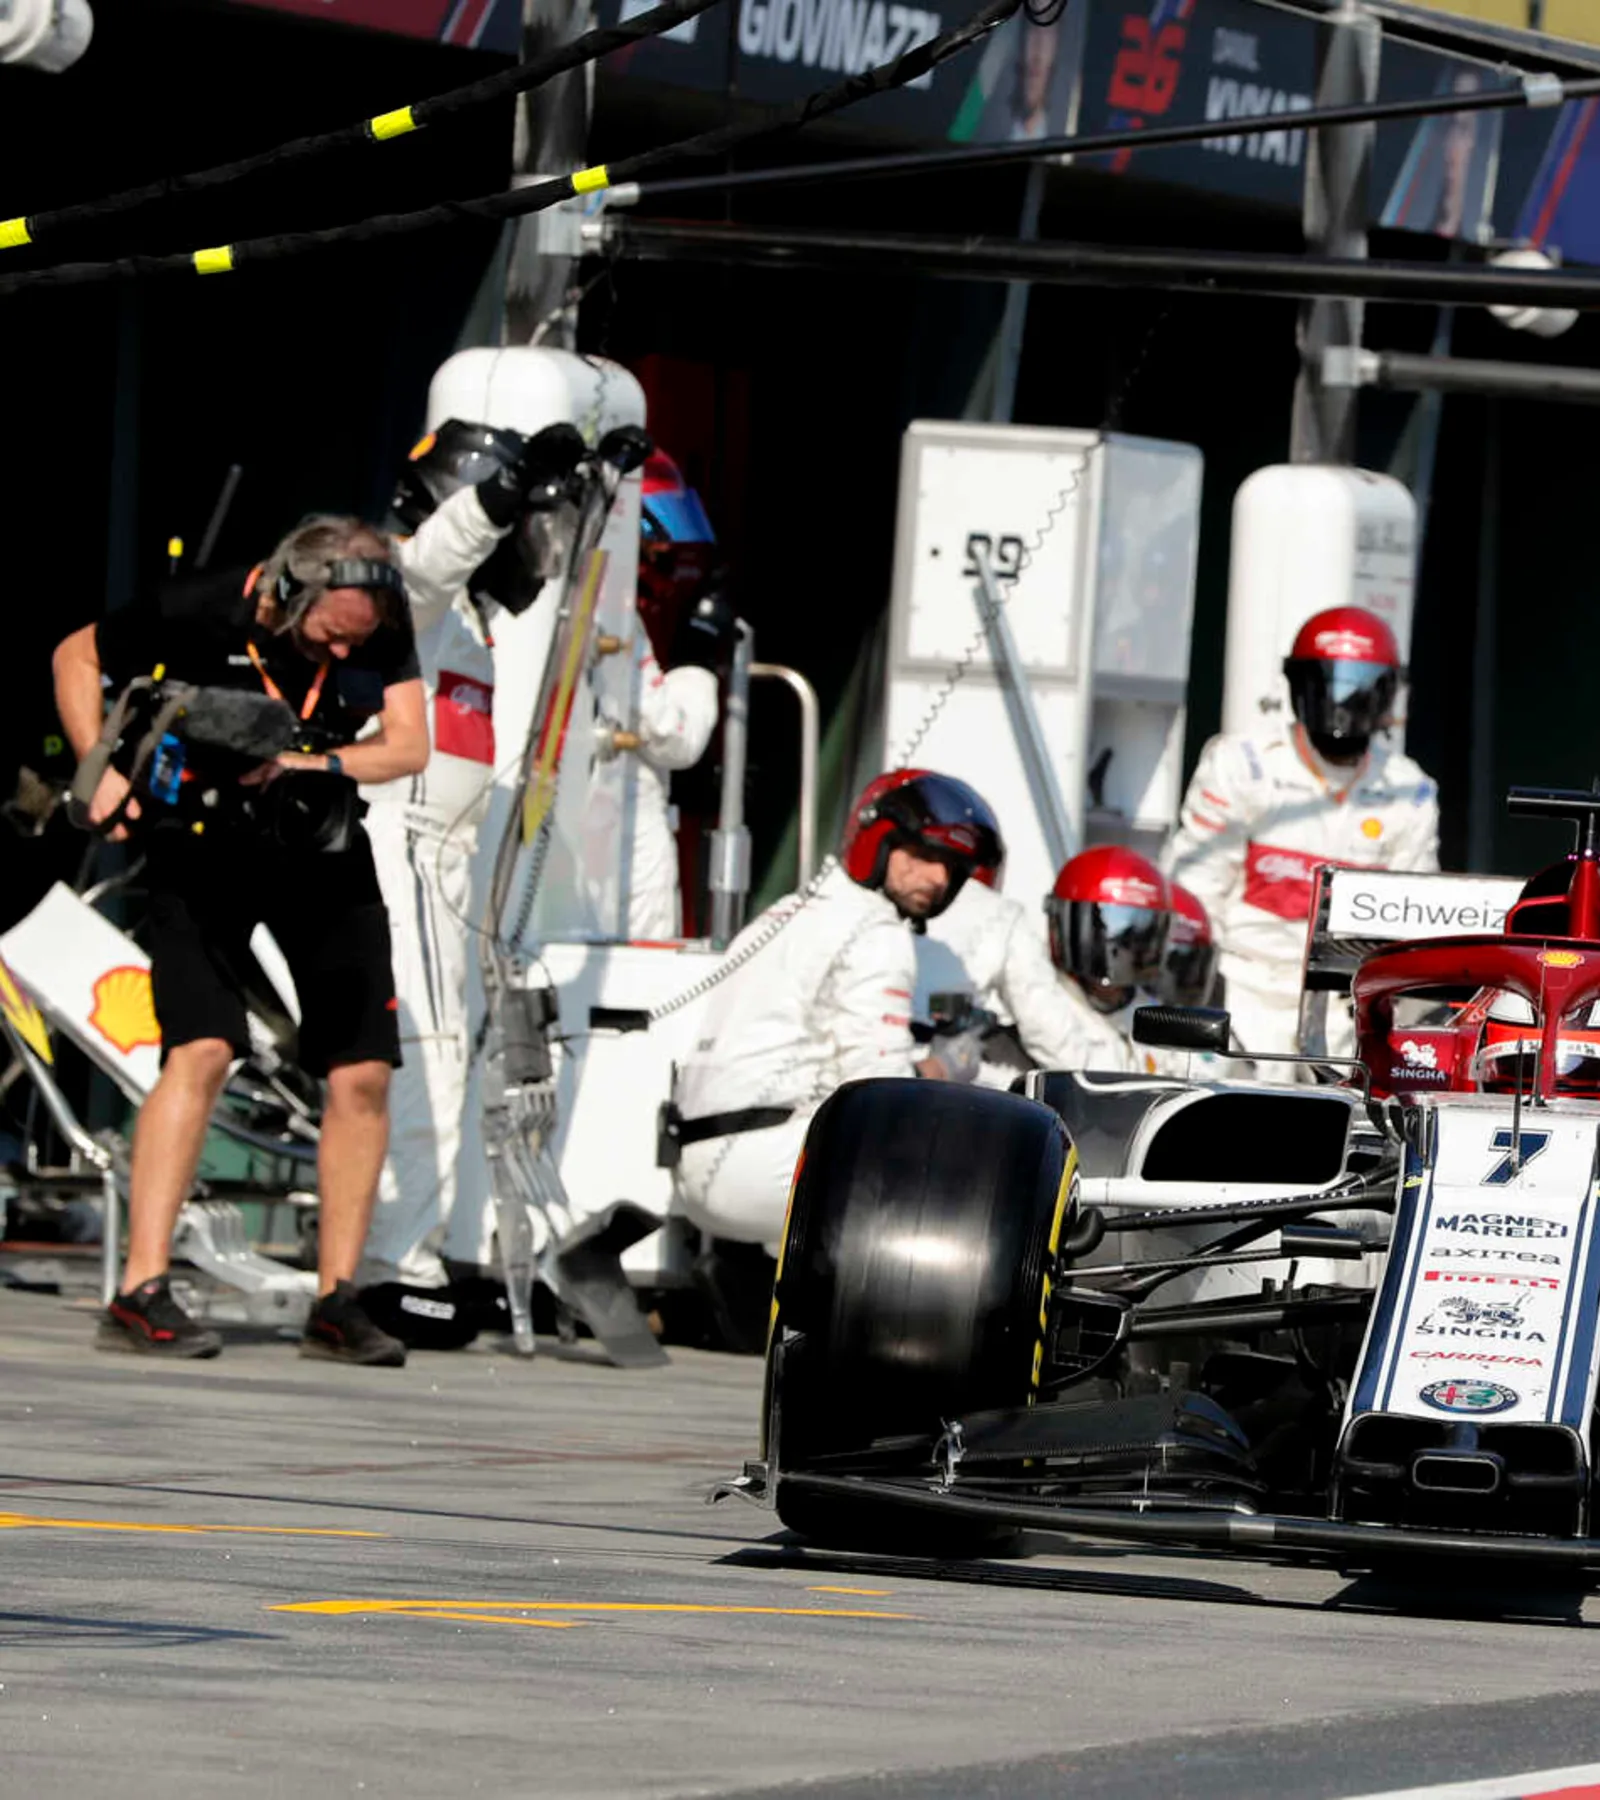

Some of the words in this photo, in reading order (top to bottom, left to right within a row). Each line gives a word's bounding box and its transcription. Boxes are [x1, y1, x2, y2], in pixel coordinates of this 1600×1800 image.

[1349, 892, 1510, 930] Schweiz
[1390, 1066, 1447, 1082] SINGHA
[1479, 1126, 1554, 1187] 7
[1435, 1213, 1567, 1231] MAGNETI
[1435, 1219, 1568, 1238] MARELLI
[1414, 1323, 1546, 1343] SINGHA
[1410, 1351, 1543, 1367] CARRERA
